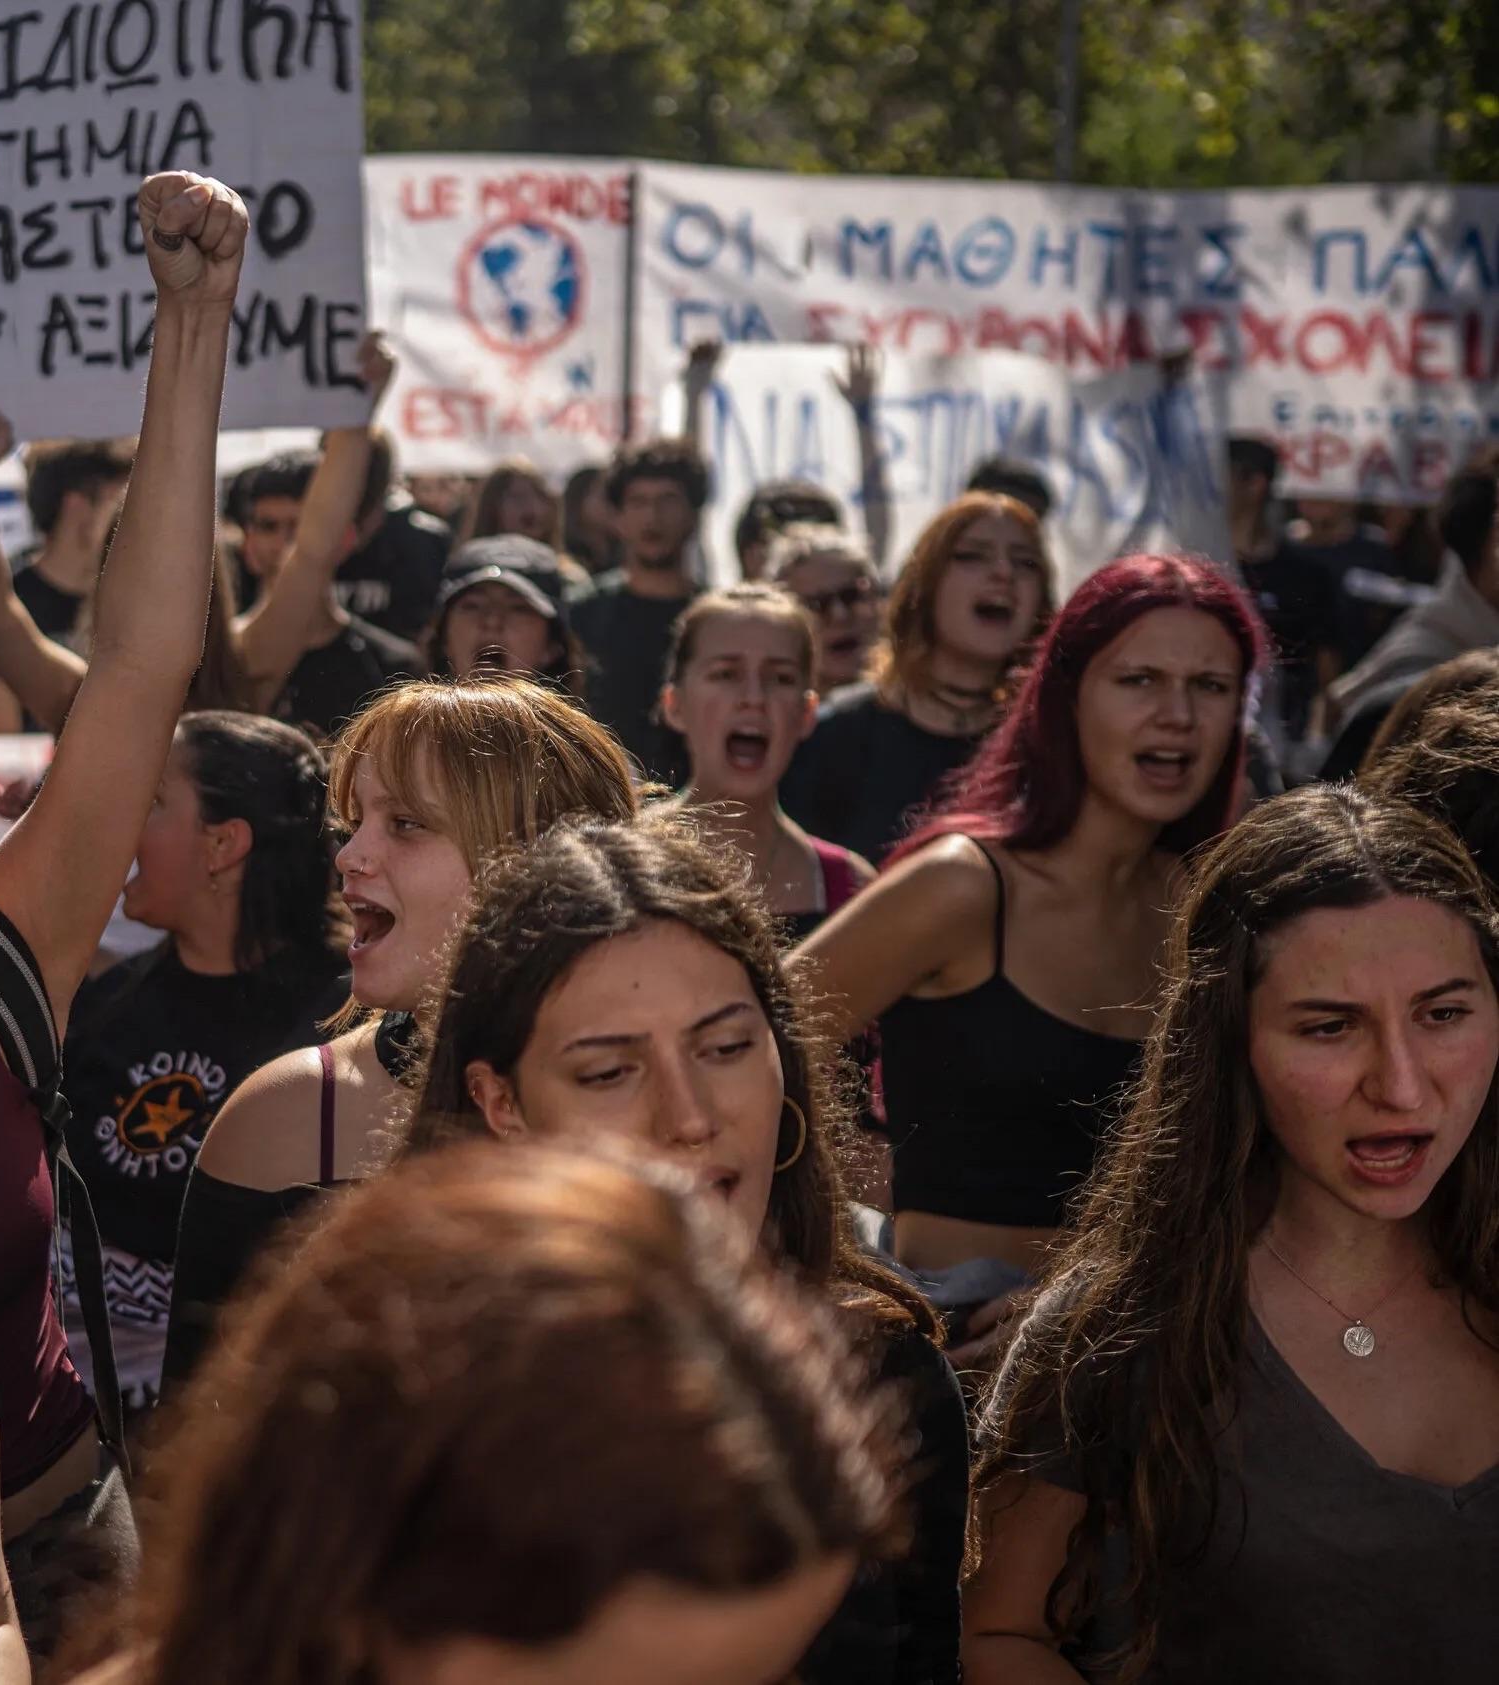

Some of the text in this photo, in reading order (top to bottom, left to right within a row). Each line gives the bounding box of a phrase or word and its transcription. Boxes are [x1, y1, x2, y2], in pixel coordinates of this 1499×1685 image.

[237, 179, 315, 260] Ο
[400, 173, 631, 227] LE MONDE
[840, 214, 1246, 297] ΜΑΘΗΤΕΣ
[38, 289, 369, 392] ΑΞΙΖΥΜΕ
[1181, 303, 1499, 383] ΣΧΟΛΕΙ
